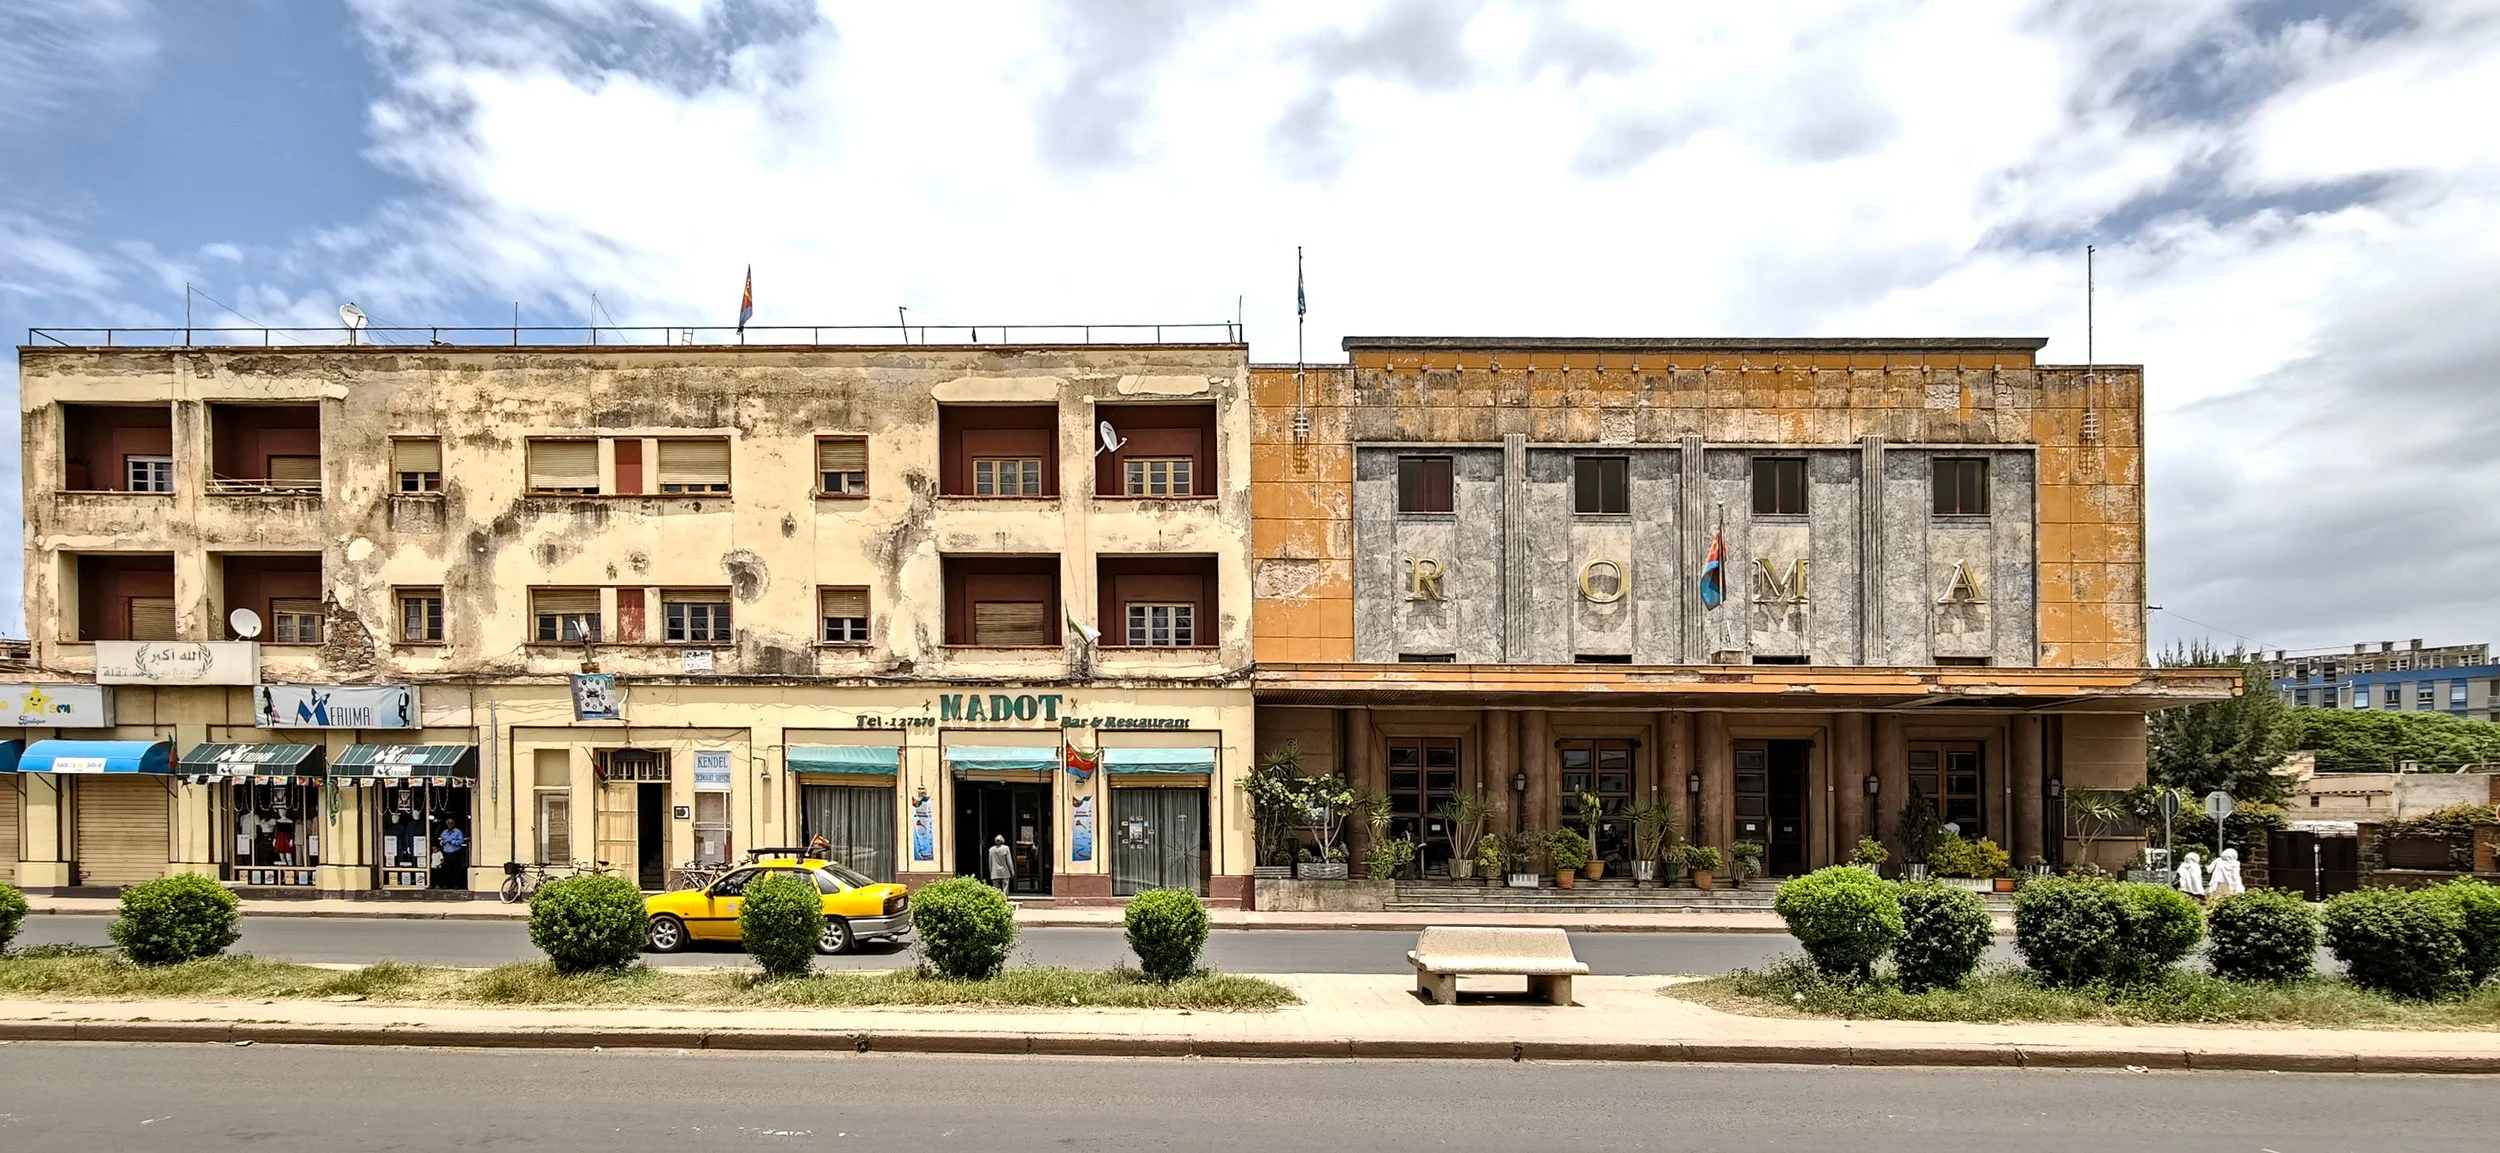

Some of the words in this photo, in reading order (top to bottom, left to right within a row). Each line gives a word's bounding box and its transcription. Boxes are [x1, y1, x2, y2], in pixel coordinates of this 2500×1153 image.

[1404, 556, 1987, 604] ROMA
[180, 648, 202, 662] الله
[294, 698, 371, 726] MERUMA
[940, 694, 1063, 722] MADOT
[856, 715, 881, 727] Tel
[1061, 716, 1088, 728] Bar
[1090, 717, 1103, 728] &
[1104, 716, 1190, 728] Restaurant
[697, 756, 728, 768] KENDEL
